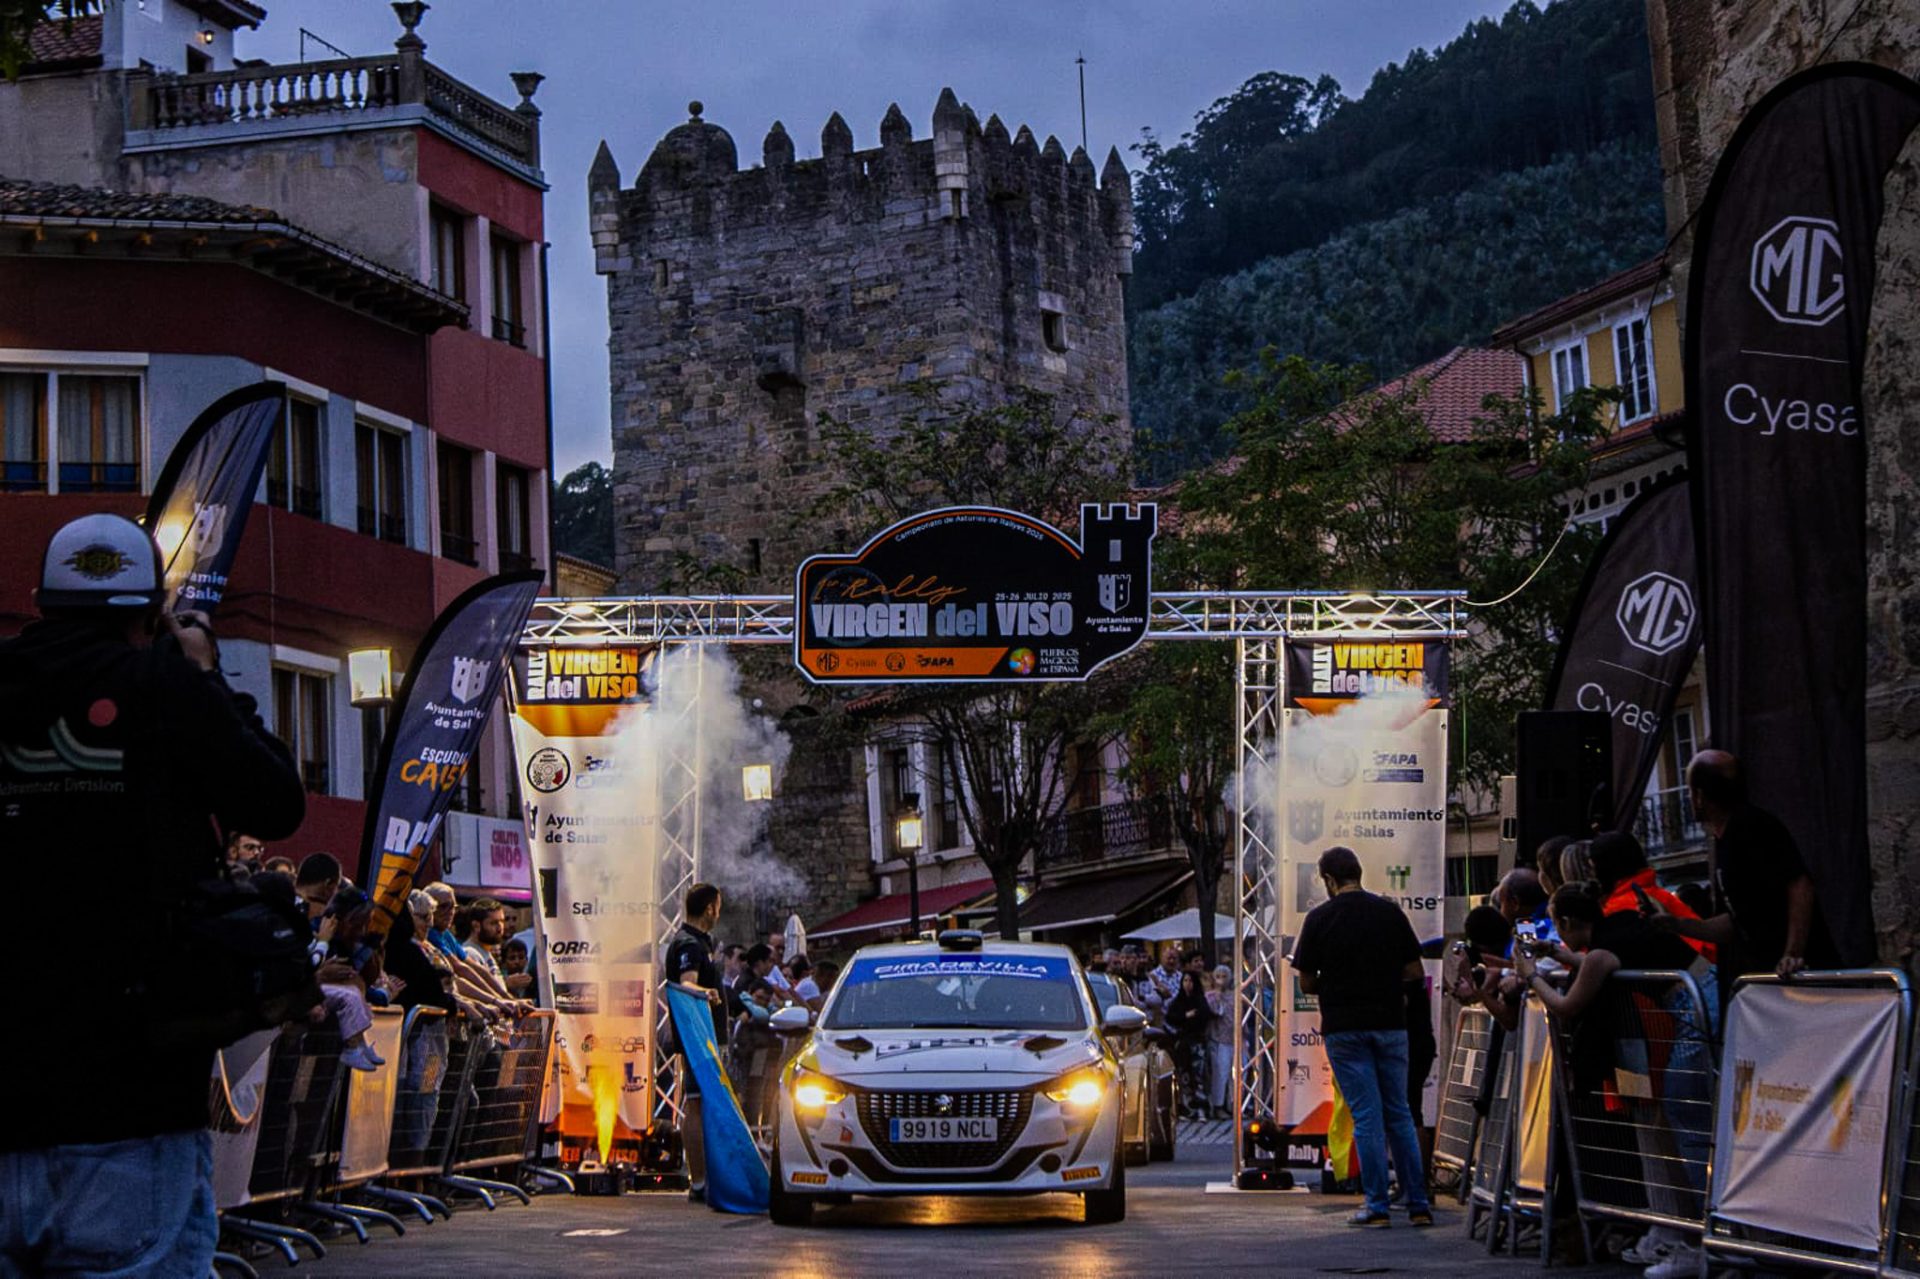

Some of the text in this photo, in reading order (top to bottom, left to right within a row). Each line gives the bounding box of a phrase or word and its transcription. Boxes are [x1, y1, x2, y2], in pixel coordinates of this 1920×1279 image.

[1760, 226, 1844, 317] MG
[895, 519, 942, 542] Campeonato
[944, 516, 954, 524] de
[955, 515, 986, 523] Asturias
[1026, 527, 1044, 540] 2025
[841, 574, 967, 605] Rally
[1023, 592, 1048, 601] JULIO
[1052, 592, 1073, 600] 2025
[811, 602, 1073, 638] VIRGEN del VISO
[1085, 617, 1143, 626] Ayuntamiento
[1624, 579, 1690, 649] MG
[1098, 625, 1131, 633] de Salas
[549, 649, 638, 675] VIRGEN
[1040, 648, 1079, 656] PUEBLOS
[1333, 643, 1424, 669] VIRGEN
[546, 676, 638, 699] del VISO
[1333, 671, 1367, 693] del
[434, 716, 450, 728] de
[1333, 808, 1443, 824] Ayuntamiento
[544, 832, 562, 843] de
[1333, 826, 1395, 838] de Salas
[903, 1121, 992, 1138] 9919 NCL
[1287, 1144, 1320, 1165] Rally
